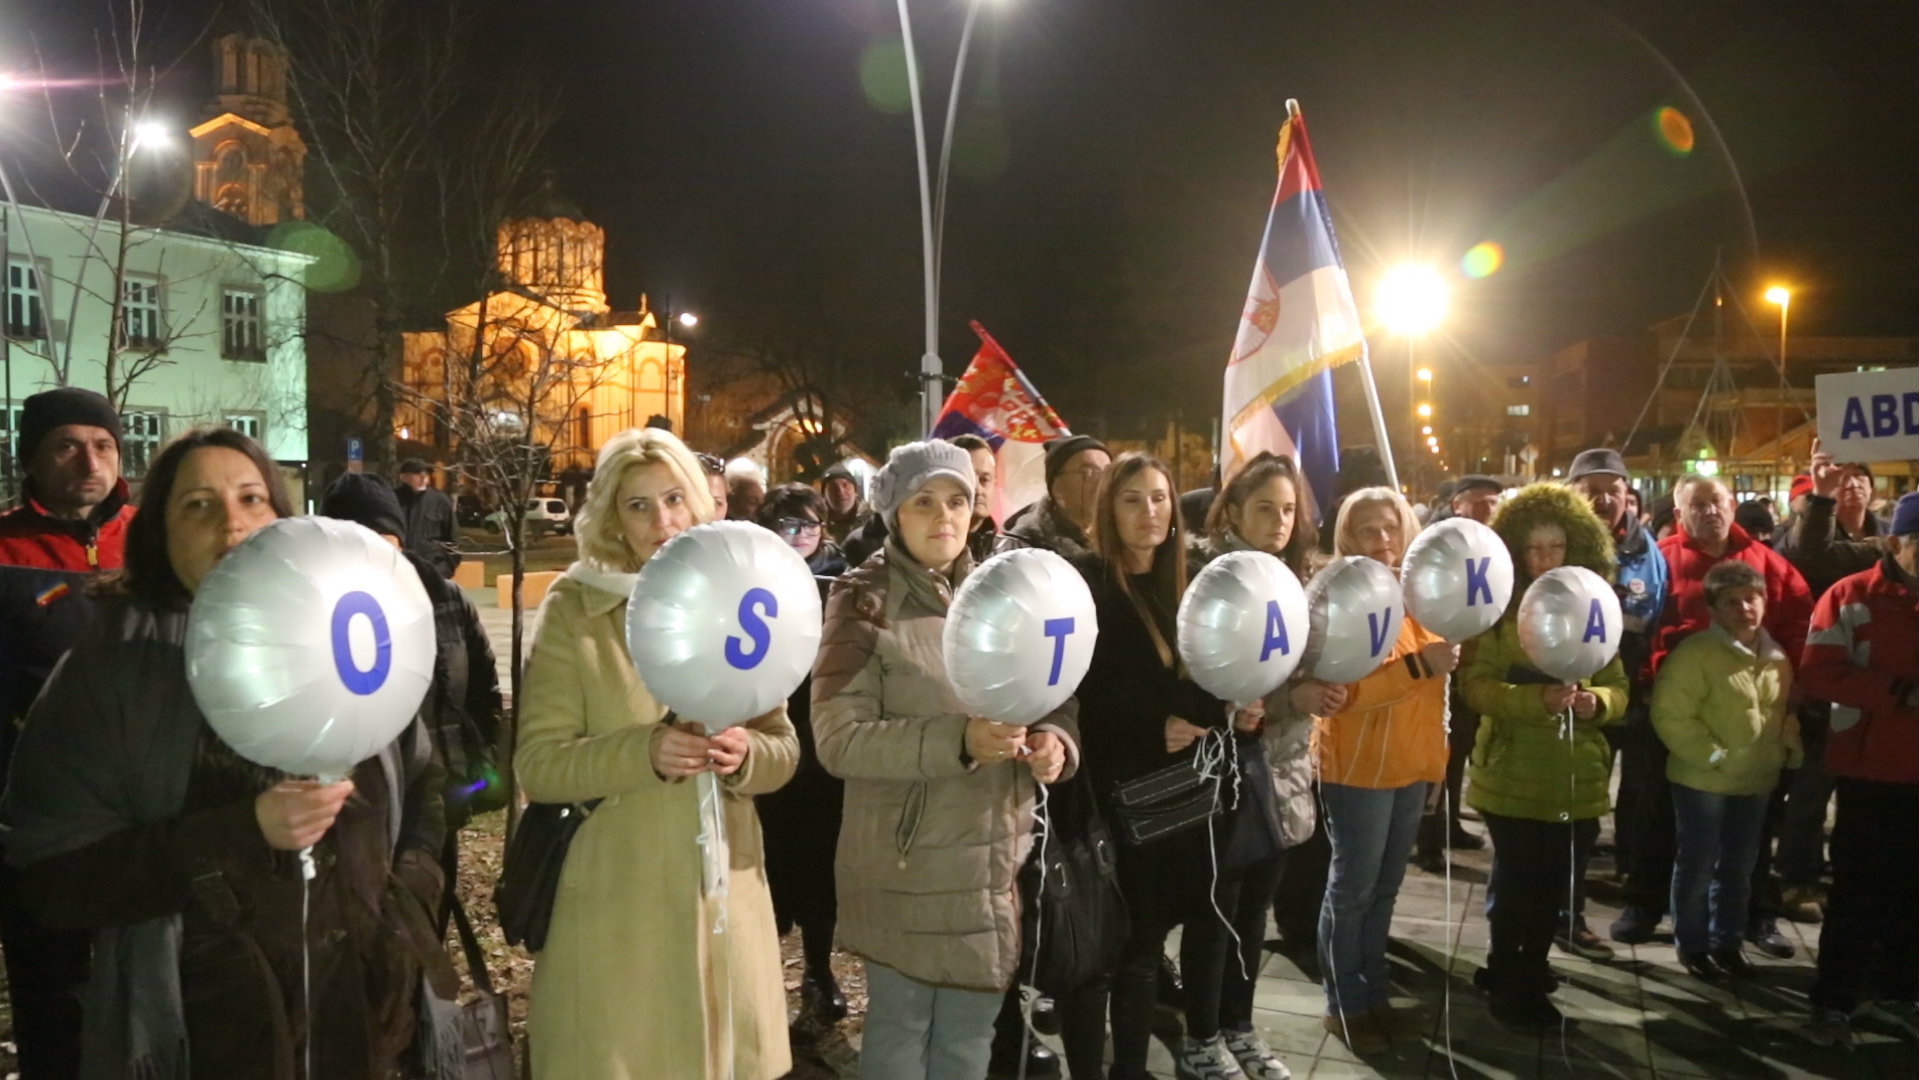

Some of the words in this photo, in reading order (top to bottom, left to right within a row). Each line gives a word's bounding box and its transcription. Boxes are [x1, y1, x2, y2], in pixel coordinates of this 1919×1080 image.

[1466, 557, 1492, 607] K
[331, 590, 392, 696] O
[725, 587, 778, 671] S
[1260, 601, 1290, 662] A
[1368, 606, 1391, 656] V
[1583, 598, 1606, 643] A
[1045, 617, 1075, 686] T
